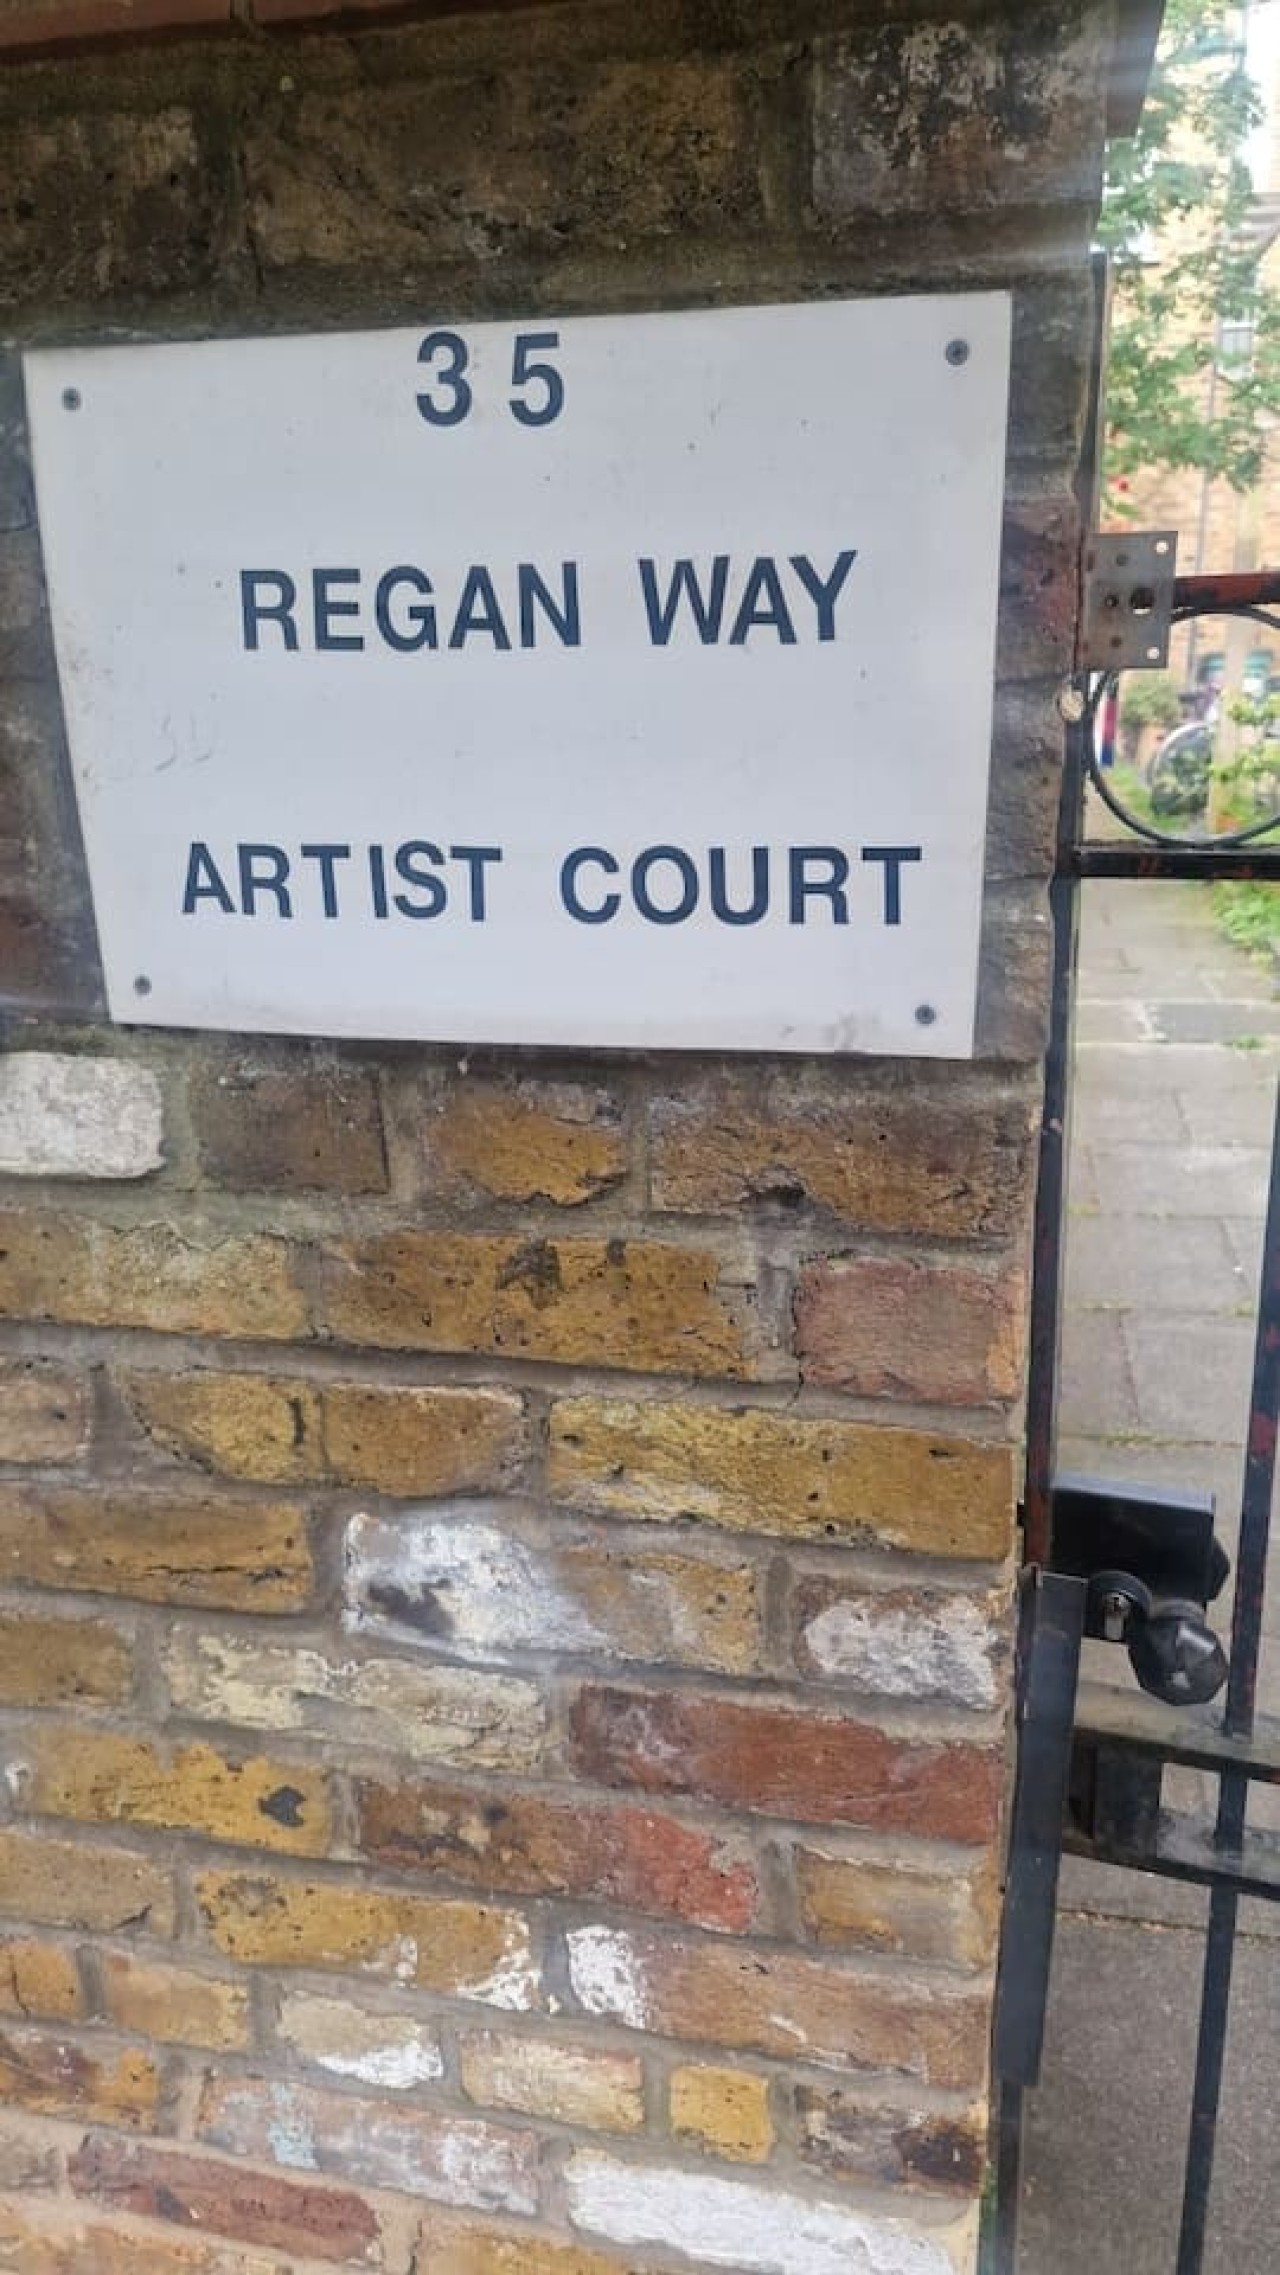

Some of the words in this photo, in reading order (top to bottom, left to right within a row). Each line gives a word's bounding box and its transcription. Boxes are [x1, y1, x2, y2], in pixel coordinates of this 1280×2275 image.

[415, 331, 564, 427] 35
[241, 561, 580, 652] REGAN
[638, 550, 858, 646] WAY
[182, 842, 502, 921] ARTIST
[560, 846, 923, 926] COURT
